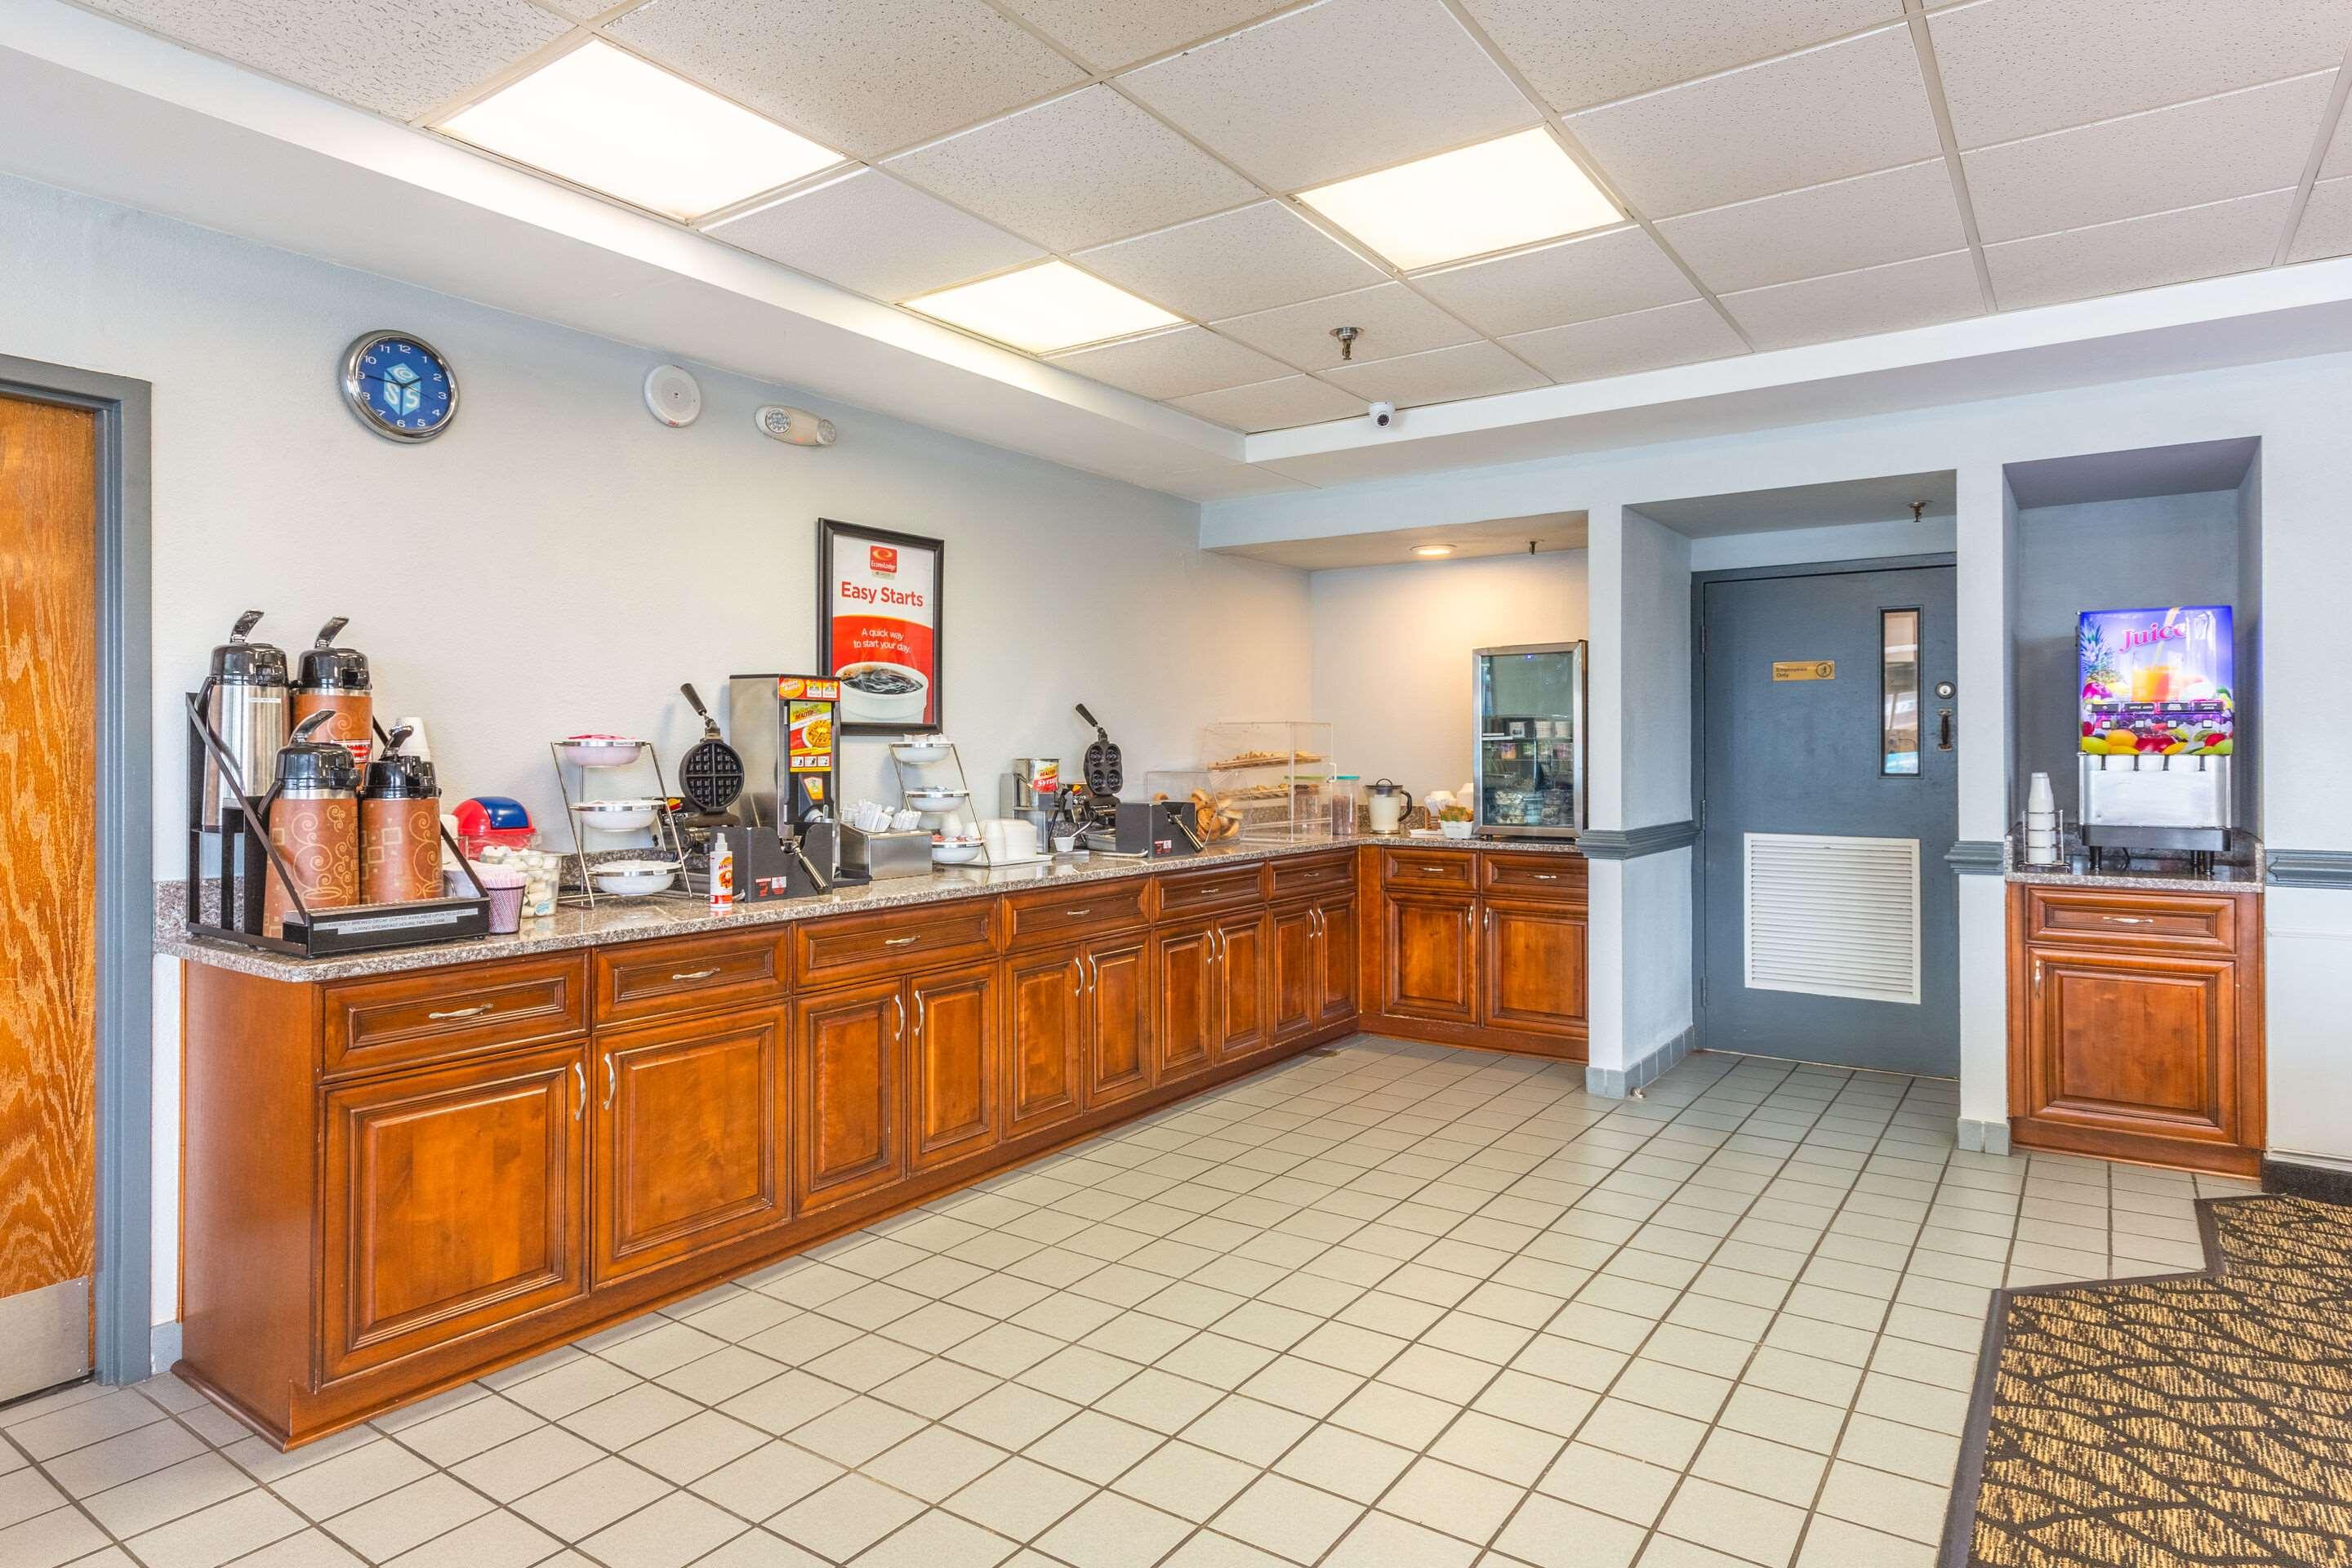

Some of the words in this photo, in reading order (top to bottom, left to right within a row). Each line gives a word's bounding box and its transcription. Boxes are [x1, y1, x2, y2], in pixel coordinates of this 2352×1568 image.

[379, 345, 390, 354] 11
[398, 344, 412, 354] 12
[364, 355, 376, 365] 10
[358, 372, 366, 380] 9
[433, 373, 443, 381] 2
[362, 392, 371, 401] 8
[438, 392, 447, 400] 3
[432, 408, 441, 416] 4
[397, 419, 406, 428] 6
[417, 419, 425, 427] 5
[841, 581, 877, 604] Easy
[880, 586, 924, 608] Starts
[862, 628, 867, 636] A
[869, 628, 889, 639] quick
[889, 631, 904, 641] way
[2119, 623, 2186, 653] Juice
[853, 640, 862, 648] to
[862, 640, 879, 648] start
[880, 641, 896, 652] your
[897, 643, 911, 653] day.
